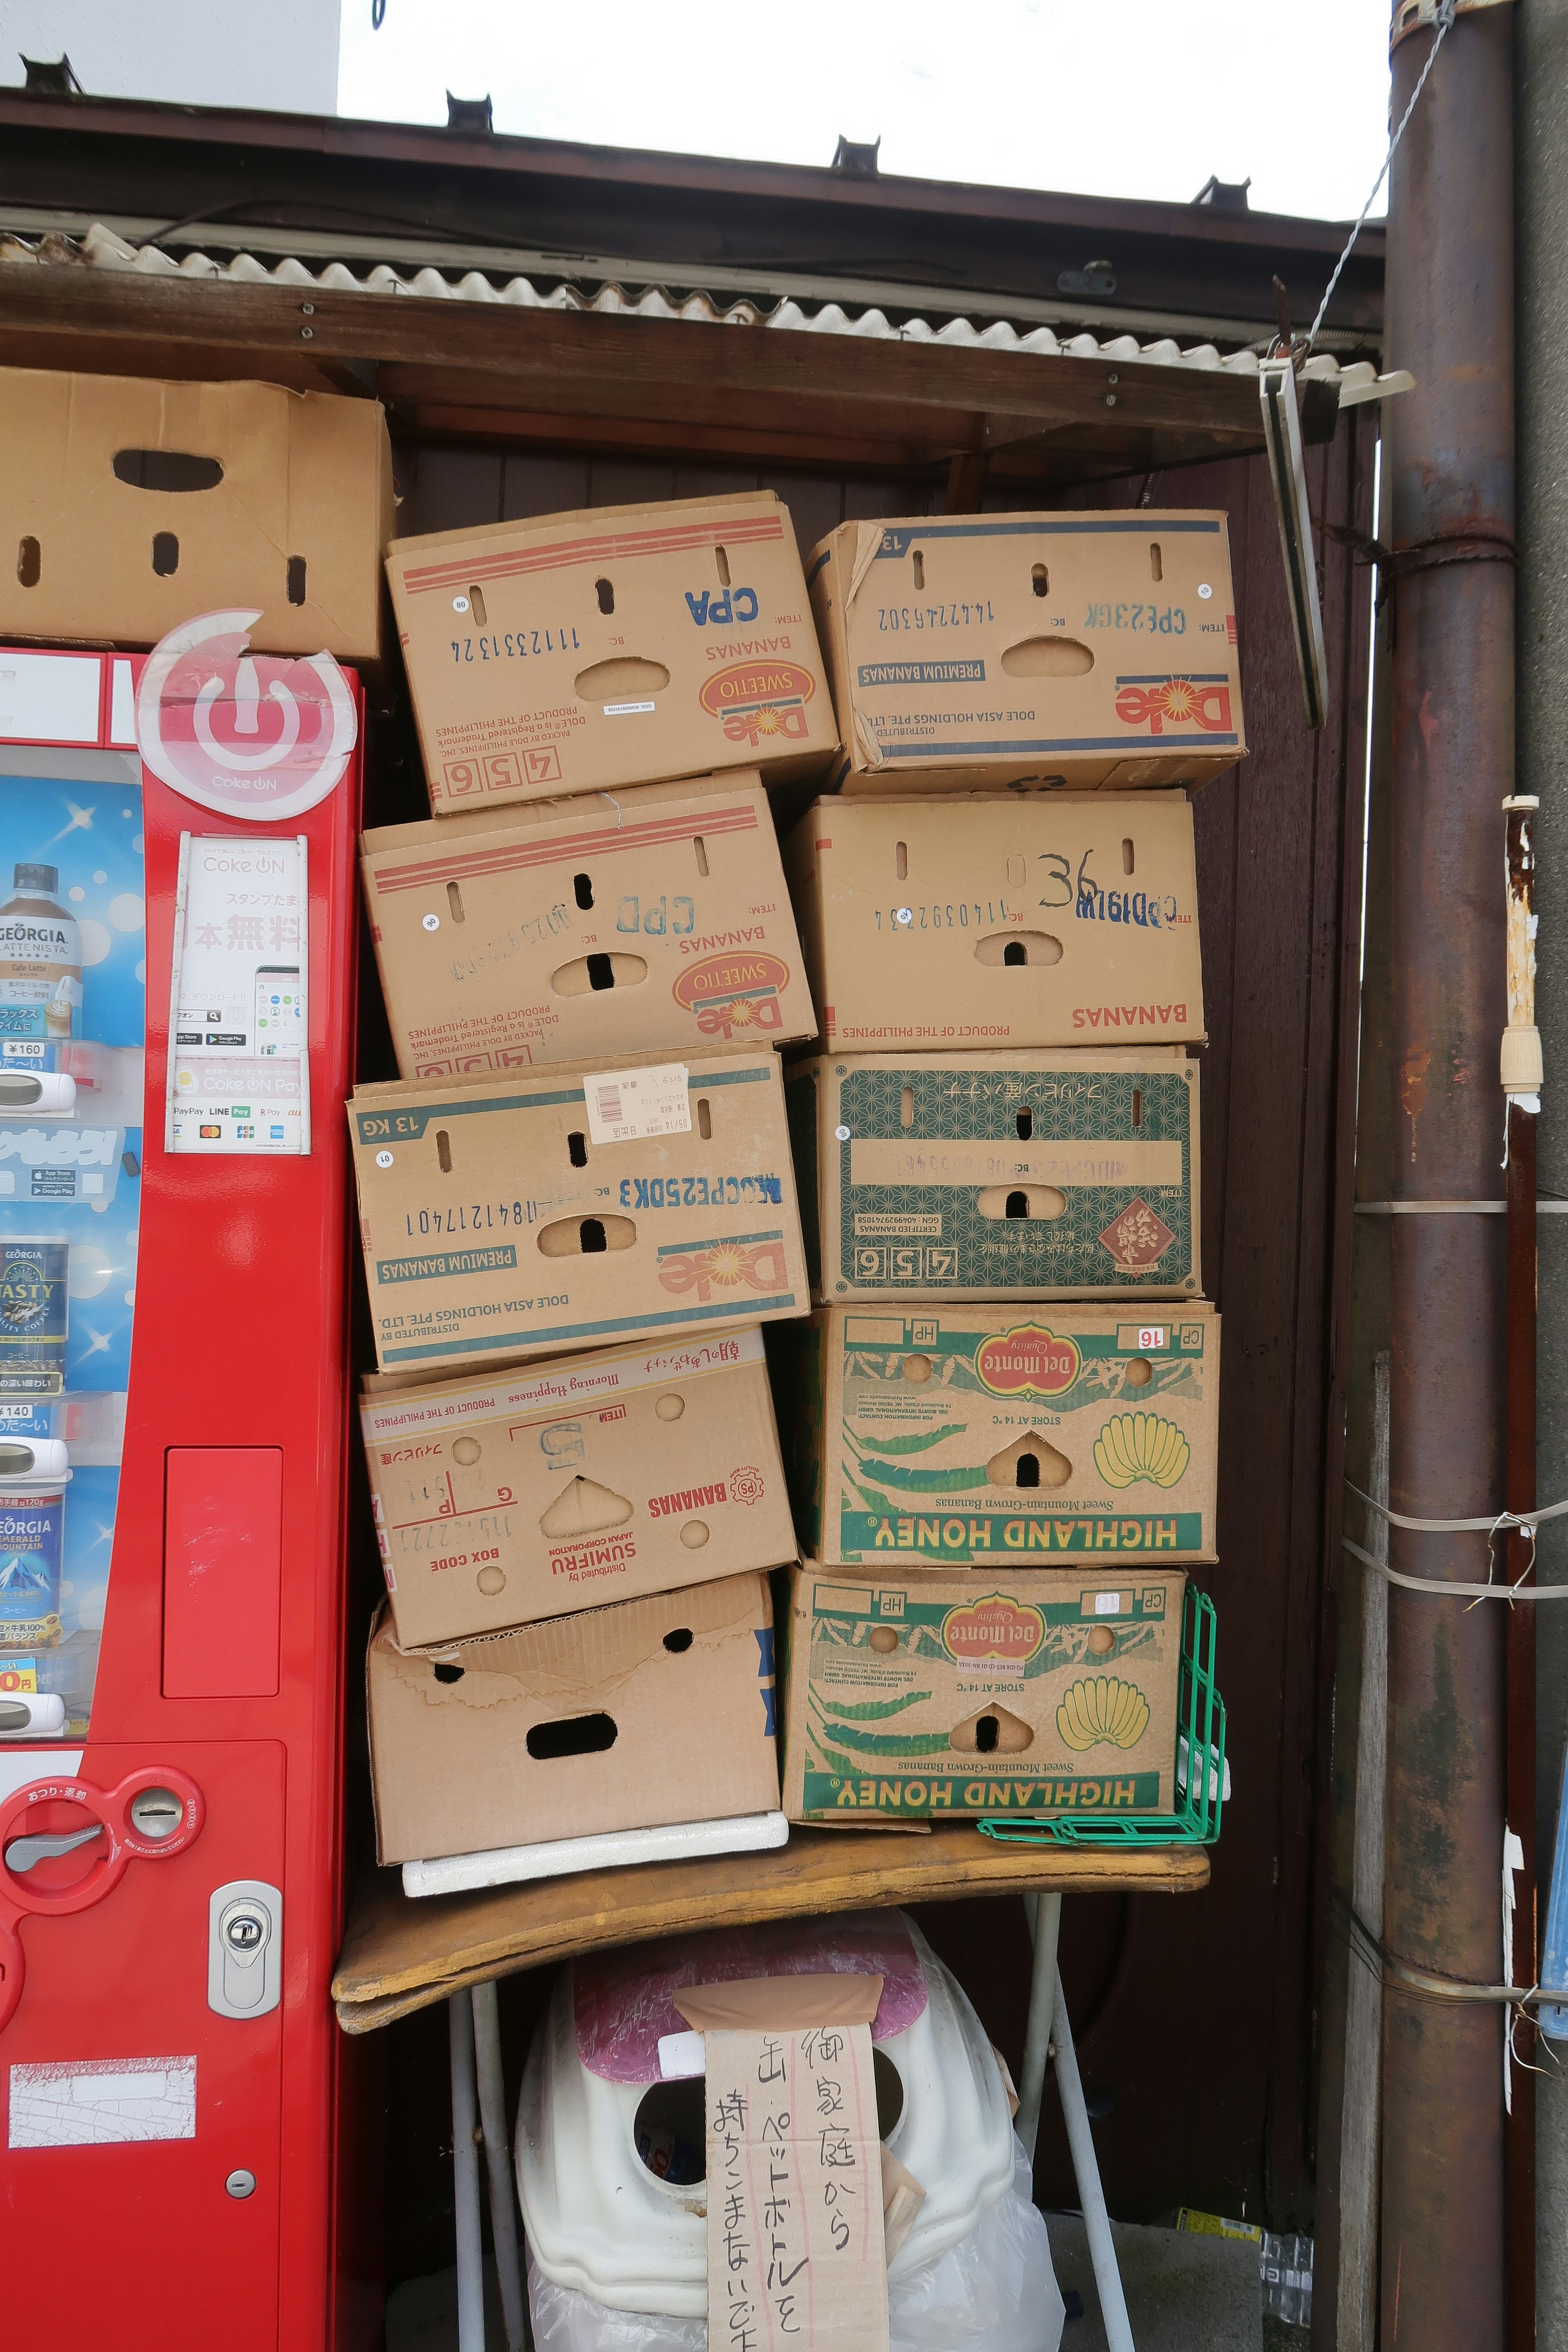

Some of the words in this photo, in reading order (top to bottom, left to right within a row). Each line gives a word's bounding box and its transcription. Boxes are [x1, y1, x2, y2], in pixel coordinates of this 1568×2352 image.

[882, 535, 902, 551] 13
[1200, 587, 1210, 595] 10
[685, 587, 759, 626] CPA
[775, 613, 803, 625] ITEM:
[450, 627, 580, 663] 1112331324
[706, 635, 792, 661] BANANAS
[862, 665, 921, 683] BANANAS
[924, 664, 981, 679] PREMIUM
[720, 672, 793, 698] SWEETIO
[533, 705, 578, 721] PRODUCT
[1115, 679, 1233, 735] Dole
[498, 716, 516, 726] THE
[518, 714, 531, 723] OF
[723, 705, 810, 747] Dole
[435, 718, 496, 737] PHILIPPINES
[546, 729, 570, 741] PACKED
[877, 726, 935, 737] DISTRIBUTED
[459, 738, 508, 755] PHILIPPINES,
[509, 736, 530, 747] DOLE
[533, 734, 545, 743] BY
[440, 748, 457, 758] INC.
[490, 758, 511, 786] 5
[528, 752, 552, 778] 4
[212, 776, 251, 790] Coke
[254, 773, 277, 791] ON
[450, 764, 472, 792] 6
[203, 856, 252, 873] Coke
[256, 855, 285, 874] ON
[1038, 848, 1099, 907] 36
[616, 895, 695, 935] CPD
[748, 903, 777, 915] ITEM:
[581, 934, 597, 944] BC:
[679, 925, 766, 955] BANANAS
[28, 964, 47, 972] Latte
[694, 962, 767, 992] SWEETIO
[10, 990, 50, 1000] コーヒー飲料
[696, 995, 784, 1040] Dole
[1072, 1003, 1187, 1029] BANANAS
[842, 1026, 913, 1038] PHILIPPINES
[916, 1026, 938, 1037] THE
[941, 1026, 955, 1036] OF
[958, 1025, 1010, 1036] PRODUCT
[9, 1044, 40, 1055] ¥160
[203, 1077, 244, 1091] Coke
[247, 1076, 271, 1092] ON
[621, 1080, 637, 1090] 直送
[943, 1081, 1102, 1100] フィリピン産バナナ
[174, 1107, 204, 1116] PayPay
[363, 1118, 390, 1137] KG
[396, 1115, 419, 1133] 13
[613, 1125, 637, 1139] 日出店
[665, 1118, 687, 1130] 05/14
[380, 1155, 390, 1163] 01
[1014, 1164, 1029, 1173] BC:
[1159, 1189, 1182, 1197] ITEM:
[860, 1225, 896, 1234] BANANAS
[5, 1248, 43, 1259] GEORGIA
[452, 1249, 512, 1269] PREMIUM
[382, 1259, 445, 1280] BANANAS
[860, 1250, 879, 1276] 6
[897, 1250, 914, 1276] 5
[931, 1250, 952, 1276] 4
[658, 1240, 789, 1303] Dole
[504, 1296, 534, 1313] ASIA
[538, 1294, 570, 1309] DOLE
[406, 1311, 432, 1325] PTE.
[435, 1302, 502, 1321] HOLDINGS
[377, 1316, 404, 1329] LTD.
[395, 1322, 460, 1339] DISTRIBUTED
[380, 1332, 393, 1342] BY
[915, 1326, 934, 1341] HP
[1140, 1330, 1162, 1348] 16
[1182, 1329, 1199, 1344] CP
[1011, 1339, 1047, 1354] Quality
[643, 1340, 741, 1374] 朝のしあわせバナナ
[985, 1354, 1041, 1375] Monte
[1044, 1355, 1071, 1374] Del
[570, 1372, 620, 1392] Morning
[508, 1382, 567, 1403] Happiness
[380, 1443, 444, 1466] フィリピン産
[497, 1486, 513, 1501] G
[648, 1482, 728, 1519] BANANAS
[438, 1499, 452, 1514] P
[935, 1498, 983, 1509] Bananas
[984, 1499, 1079, 1510] Mountain-Grown
[1082, 1499, 1114, 1510] Sweet
[607, 1531, 634, 1544] JAPAN
[874, 1516, 992, 1548] HONEY
[1004, 1519, 1177, 1549] HIGHLAND
[472, 1547, 500, 1562] BOX
[548, 1537, 607, 1557] CORPORATION
[430, 1553, 468, 1572] CODE
[551, 1541, 637, 1575] SUMIFRU
[568, 1571, 580, 1583] by
[582, 1562, 626, 1579] Distributed
[883, 1597, 902, 1611] HP
[977, 1610, 1013, 1622] Quality
[950, 1625, 1006, 1643] Monte
[1011, 1625, 1035, 1642] Del
[969, 1683, 980, 1692] 14
[981, 1683, 992, 1692] AT
[995, 1683, 1025, 1692] STORE
[898, 1761, 944, 1772] Bananas
[947, 1762, 1040, 1774] Mountain-Grown
[1041, 1762, 1074, 1773] Sweet
[27, 1785, 89, 1803] おつり・返却
[837, 1778, 952, 1807] HONEY
[964, 1780, 1136, 1806] HIGHLAND
[800, 2026, 856, 2251] 御家庭から
